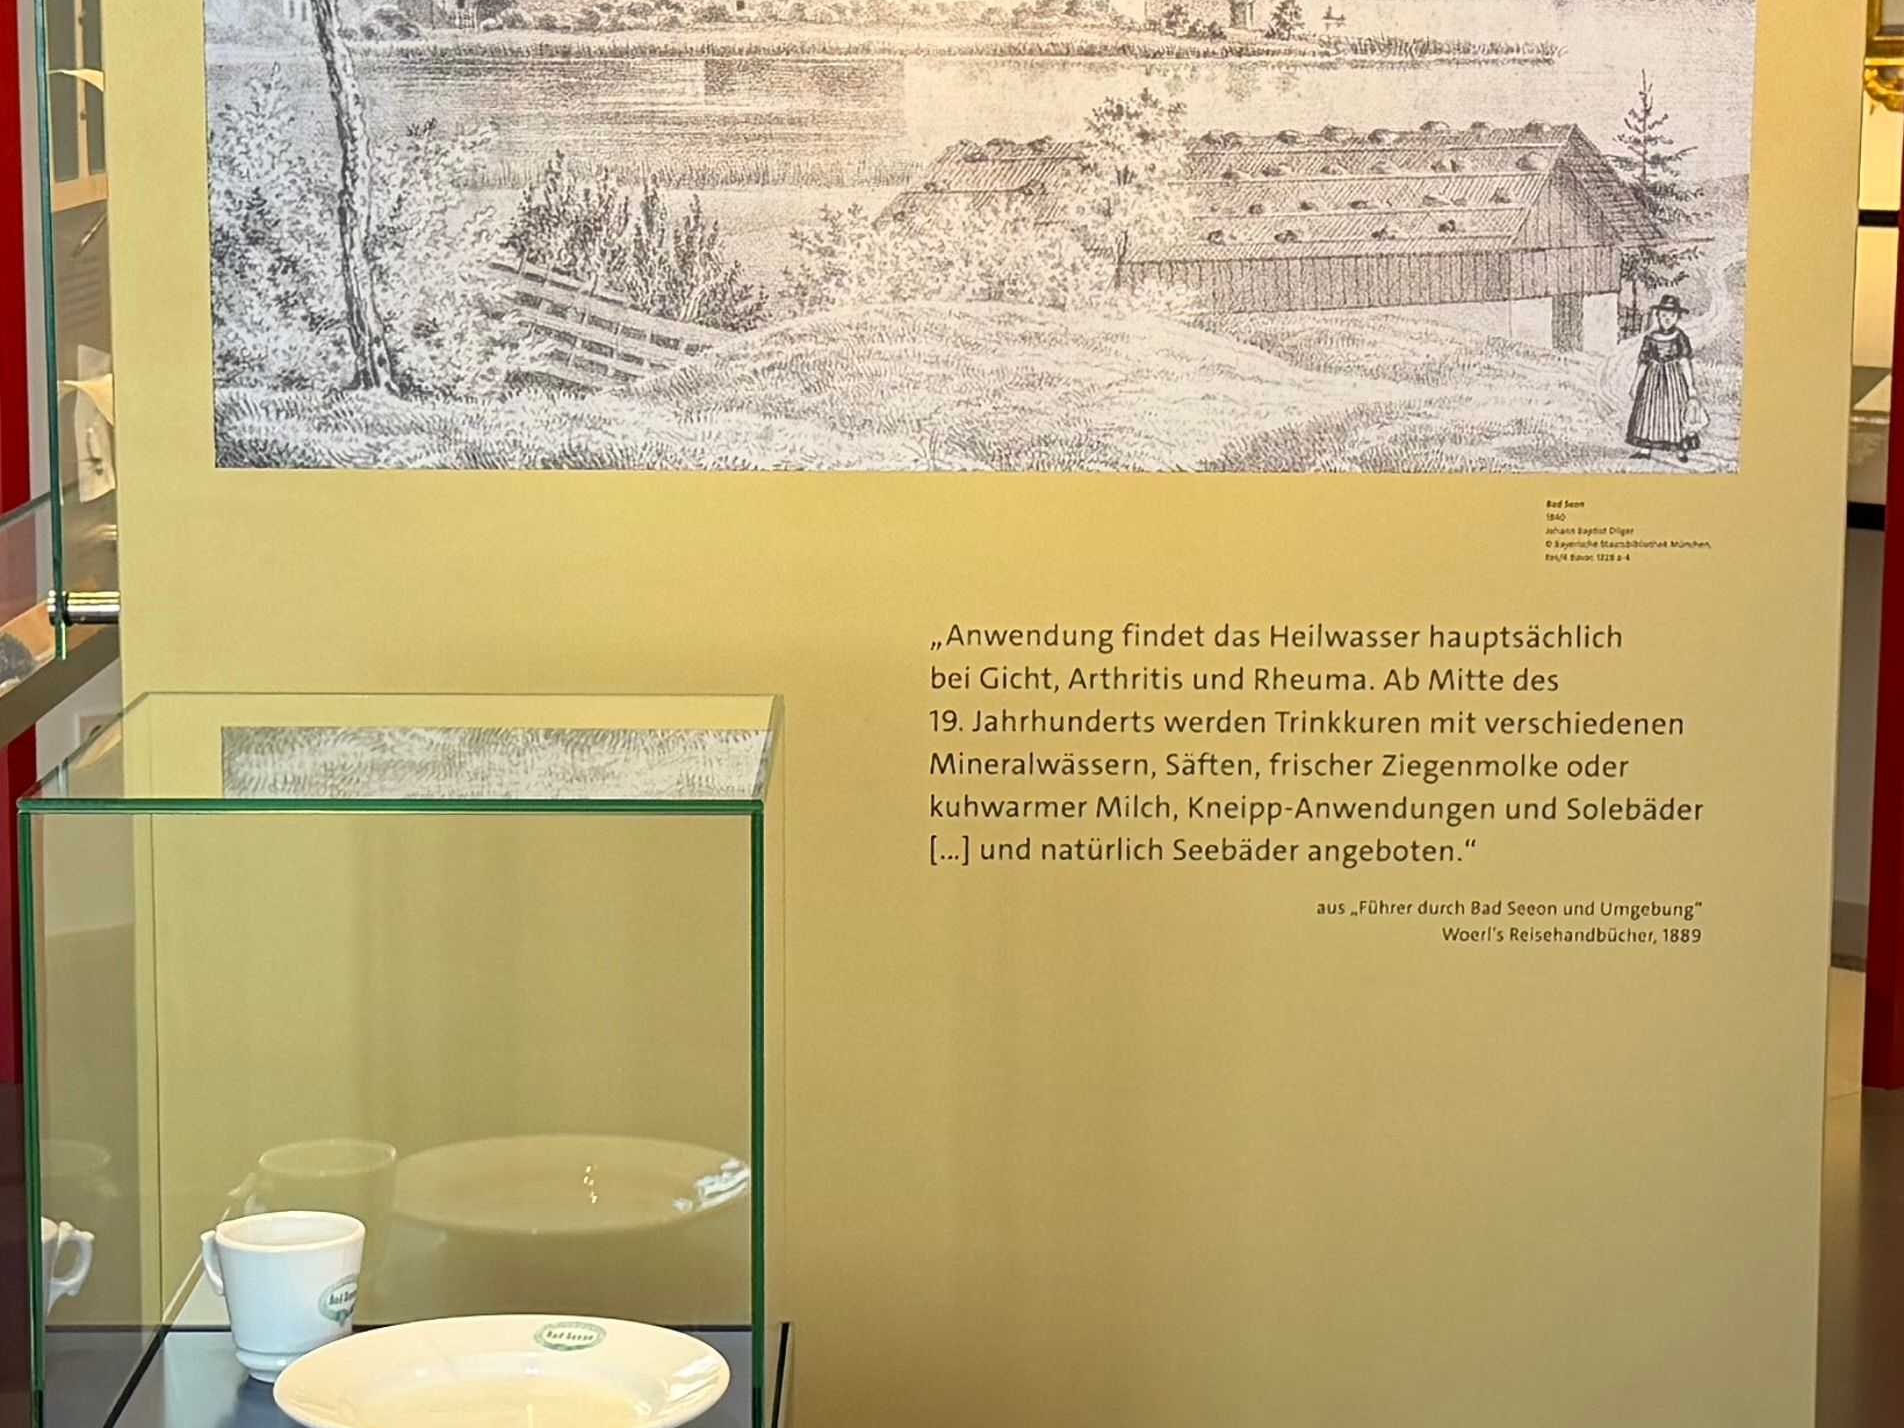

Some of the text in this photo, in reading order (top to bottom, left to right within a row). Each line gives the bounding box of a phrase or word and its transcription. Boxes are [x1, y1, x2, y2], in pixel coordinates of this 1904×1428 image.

[931, 623, 1621, 655] „Anwendung findet das Heilwasser hauptsächlich
[932, 666, 1558, 693] bei Gicht, Arthritis und Rheuma. Ab Mitte des
[930, 709, 1683, 735] 19. Jahrhunderts werden Trinkkuren mit verschiedenen
[930, 752, 1628, 784] Mineralwässern, Säften, frischer Ziegenmolke oder
[931, 794, 1703, 827] kuhwarmer Milch, Kneipp-Anwendungen und Solebäder
[931, 835, 1475, 869] [...] und natürlich Seebäder angeboten.“
[1316, 900, 1703, 922] aus „Führer durch Bad Seeon und Umgebung“
[1510, 927, 1656, 945] Reisehandbücher,
[1664, 928, 1702, 943] 1889
